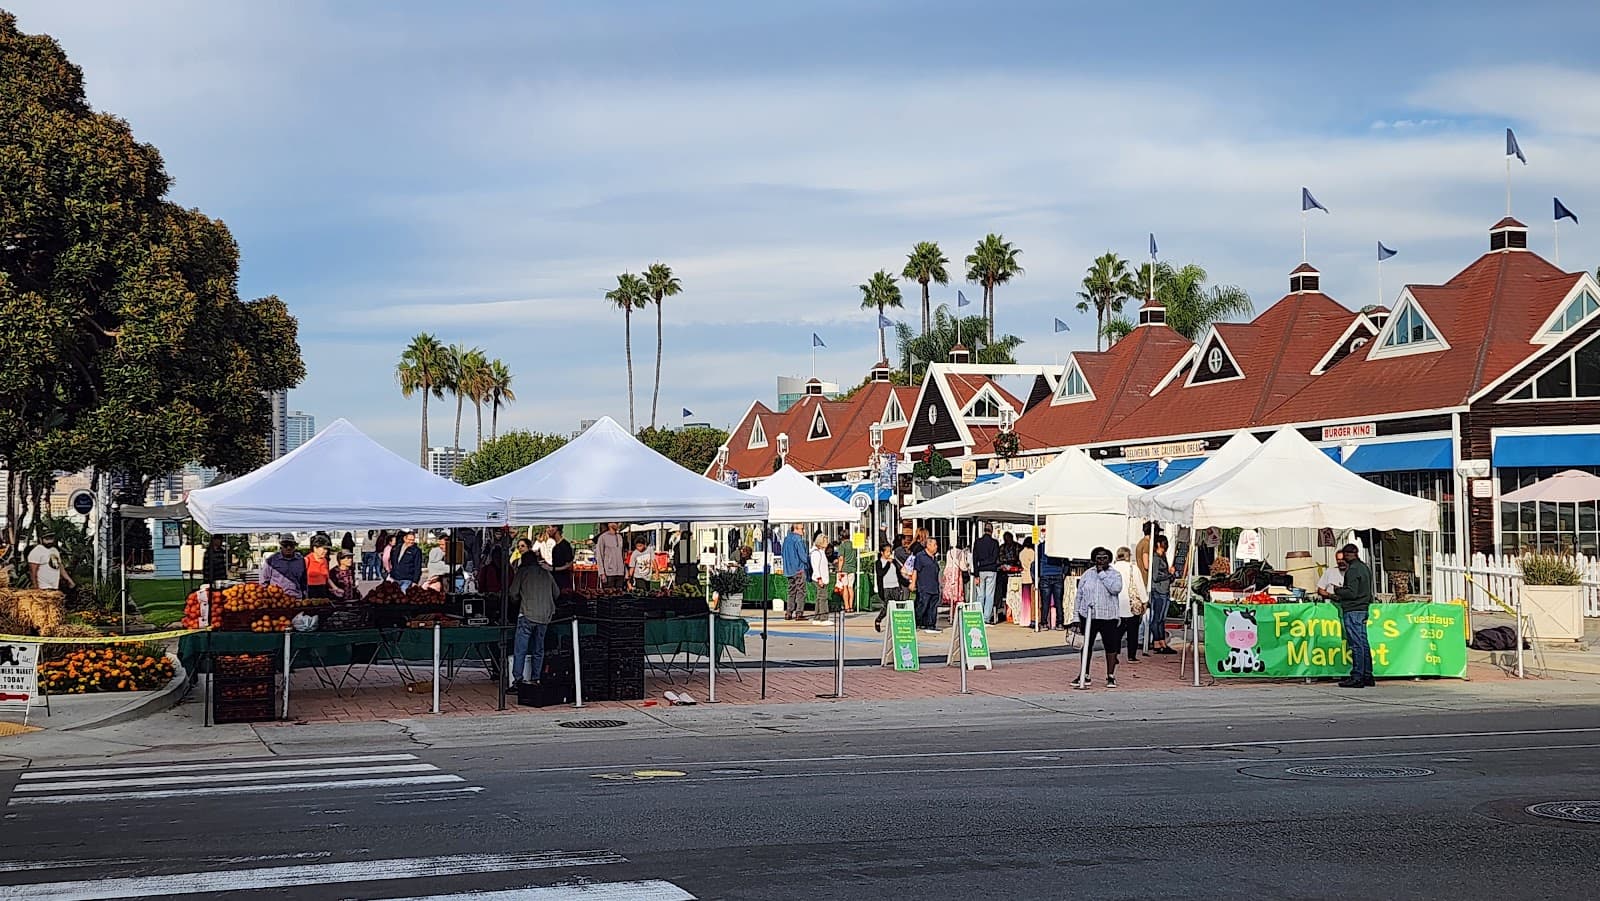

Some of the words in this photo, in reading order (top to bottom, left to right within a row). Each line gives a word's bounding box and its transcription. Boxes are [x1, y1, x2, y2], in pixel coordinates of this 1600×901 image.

[1324, 427, 1351, 438] BURGER
[1353, 425, 1370, 435] KING
[1126, 447, 1150, 458] DELIVERING
[1151, 446, 1160, 457] THE
[1161, 444, 1186, 455] CALIFORNIA
[1405, 613, 1455, 628] Tuesdays
